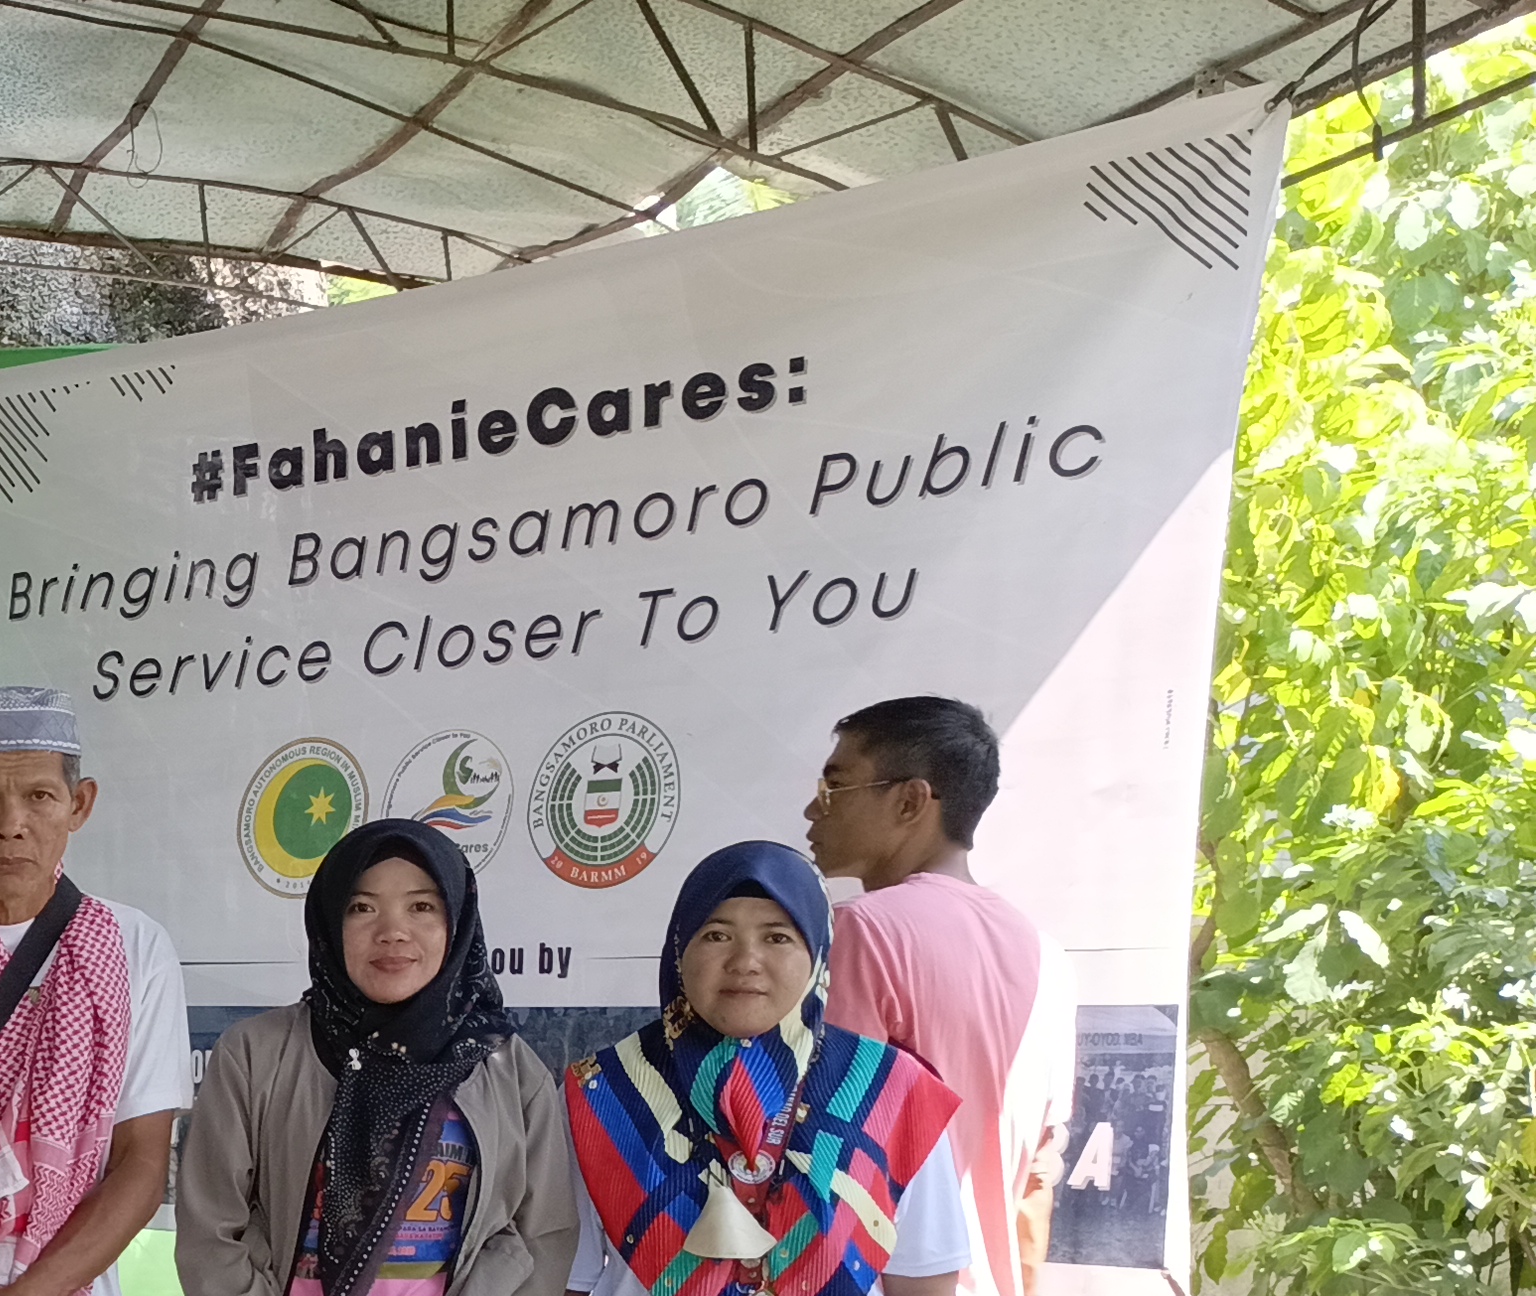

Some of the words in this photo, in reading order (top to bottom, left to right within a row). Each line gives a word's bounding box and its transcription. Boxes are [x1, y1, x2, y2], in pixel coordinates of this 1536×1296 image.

[191, 355, 808, 504] #FahanieCares:
[8, 550, 260, 622] Bringing
[288, 477, 770, 588] Bangsamoro
[809, 414, 1106, 517] Public
[92, 635, 332, 702] Service
[363, 607, 603, 678] Closer
[638, 587, 721, 650] To
[766, 567, 919, 634] You
[252, 746, 308, 799] AUTONOMOUS
[309, 745, 343, 766] REGION
[339, 759, 351, 773] IN
[532, 717, 613, 831] BANGSAMORO
[617, 717, 675, 823] PARLIAMENT
[347, 770, 363, 811] MUSLIM
[243, 797, 265, 874] BANGSAMORO
[550, 855, 564, 870] 20
[569, 864, 627, 884] BARMM
[635, 851, 648, 866] 19
[537, 941, 572, 979] by
[766, 1127, 785, 1146] SUR
